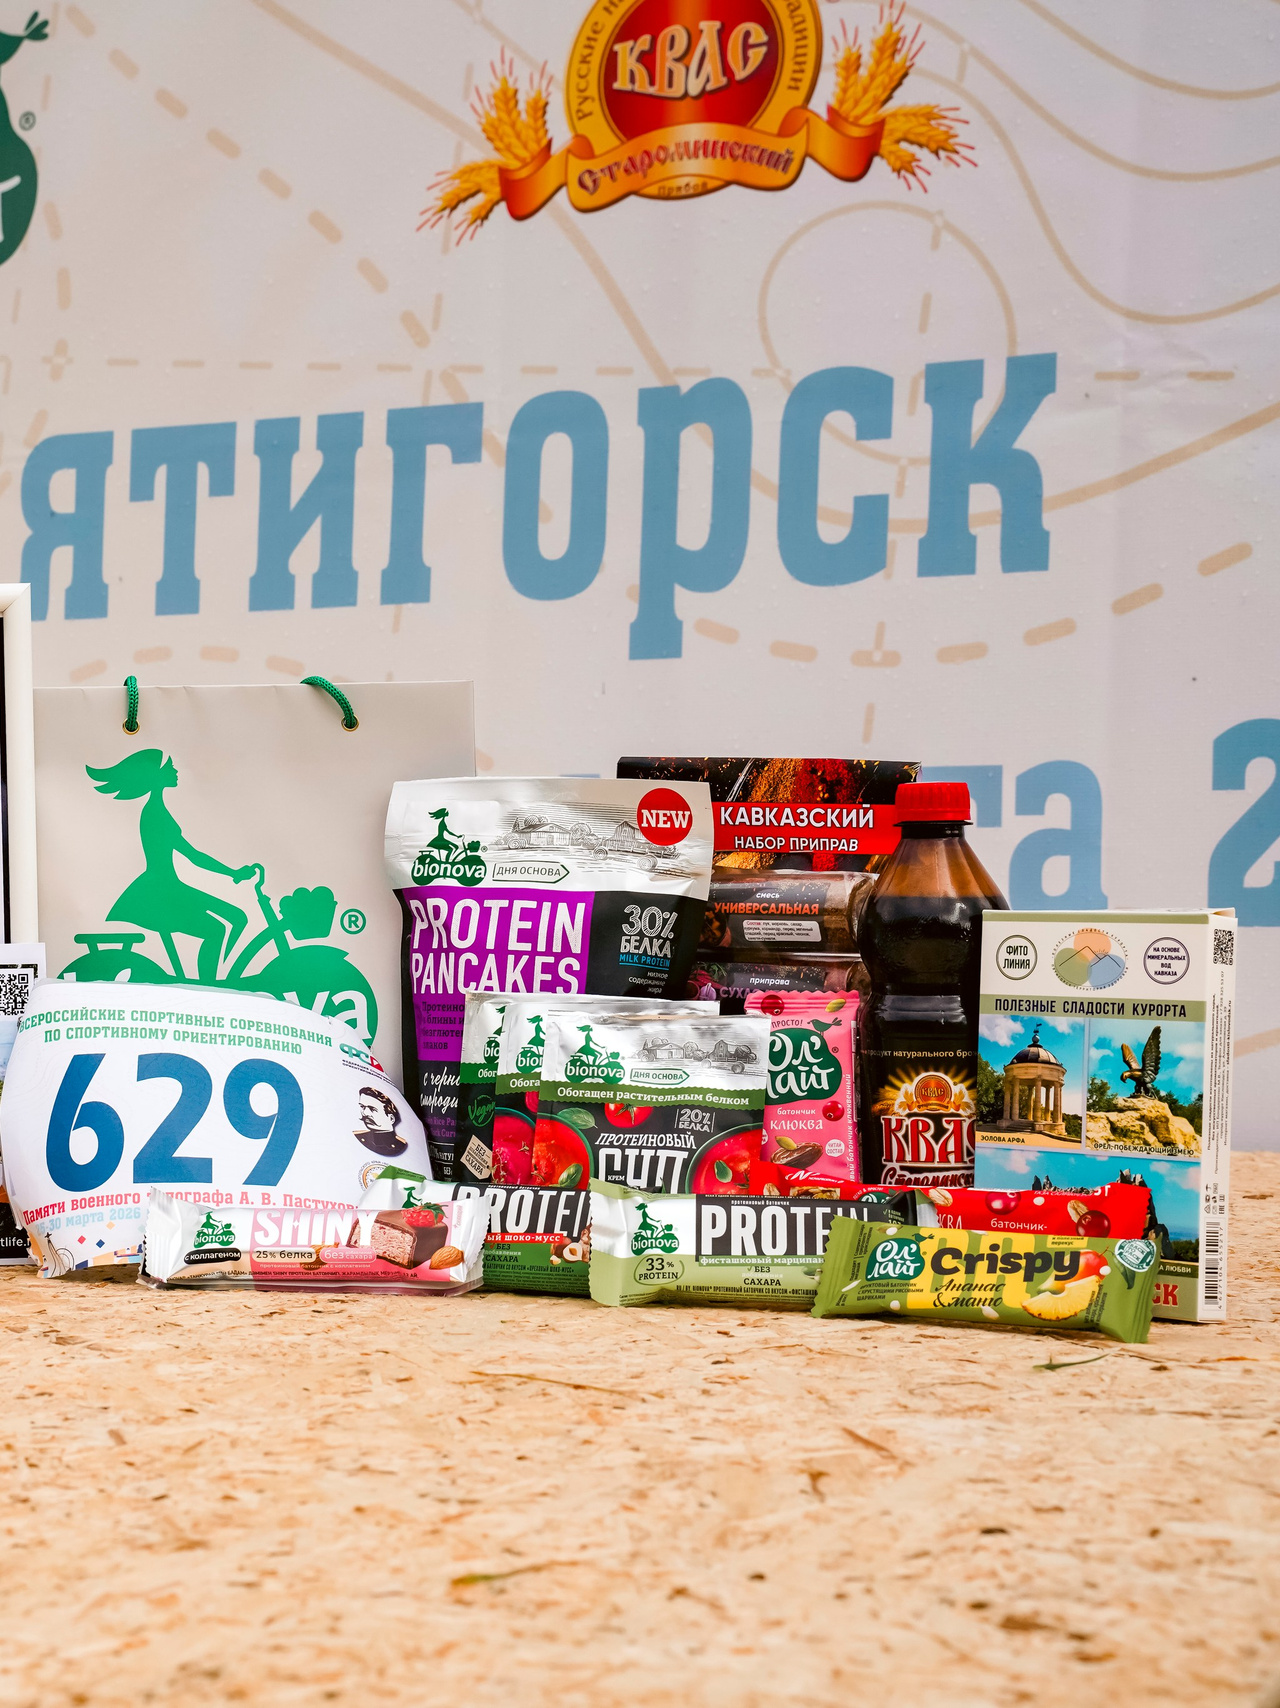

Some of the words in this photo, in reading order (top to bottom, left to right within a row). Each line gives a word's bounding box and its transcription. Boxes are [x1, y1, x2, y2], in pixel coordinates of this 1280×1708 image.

[612, 20, 769, 98] КВАС
[576, 20, 605, 121] Русские
[578, 139, 795, 195] Староминский
[641, 809, 691, 829] NEW
[720, 804, 874, 828] КАВКАЗСКИЙ
[734, 836, 786, 850] НАБОР
[789, 838, 858, 852] ПРИПРАВ
[413, 858, 486, 879] bionova
[496, 865, 517, 876] ДНЯ
[519, 865, 561, 877] ОСНОВА
[756, 891, 781, 899] смесь
[714, 902, 819, 916] УНИВЕРСАЛЬНАЯ
[410, 897, 586, 954] PROTEIN
[622, 904, 678, 940] 30%
[620, 936, 672, 959] БЕЛКА
[1006, 945, 1028, 957] ФИТО
[619, 954, 639, 964] MILK
[642, 954, 670, 968] PROTEIN
[1003, 958, 1031, 970] ЛИНИЯ
[1147, 954, 1186, 962] МИНЕРАЛЬНЫХ
[411, 951, 581, 995] PANCAKES
[628, 977, 666, 987] содержание
[750, 976, 790, 987] приправа
[995, 998, 1056, 1014] ПОЛЕЗНЫЕ
[1063, 1001, 1125, 1016] СЛАДОСТИ
[1132, 1002, 1187, 1018] КУРОРТА
[19, 1007, 126, 1033] ВСЕРОССИЙСКИЕ
[130, 1009, 225, 1029] СПОРТИВНЫЕ
[230, 1017, 333, 1047] СОРЕВНОВАНИЯ
[771, 1019, 803, 1028] ПРОСТО!
[44, 1028, 61, 1043] ПО
[66, 1026, 169, 1041] СПОРТИВНОМУ
[173, 1029, 303, 1056] ОРИЕНТИРОВАНИЮ
[893, 1049, 954, 1058] натурального
[566, 1062, 624, 1078] bionova
[633, 1071, 650, 1079] ДНЯ
[651, 1071, 684, 1081] ОСНОВА
[557, 1087, 614, 1099] Обогащен
[616, 1090, 703, 1102] растительным
[705, 1093, 749, 1105] белком
[680, 1108, 711, 1125] 20%
[777, 1108, 816, 1116] батончик
[46, 1053, 305, 1193] 629
[679, 1121, 710, 1133] БЕЛКА
[770, 1119, 823, 1131] клюква
[594, 1131, 697, 1149] ПРОТЕИНОВЫЙ
[980, 1135, 1006, 1143] ЭОЛОВА
[1007, 1136, 1025, 1144] АРФА
[23, 1201, 66, 1226] Памяти
[71, 1192, 141, 1212] военного
[65, 1211, 105, 1227] марта
[109, 1207, 141, 1220] 2026
[990, 1218, 1048, 1231] батончик-
[194, 1233, 235, 1244] bionova
[505, 1234, 560, 1243] шоко-мусс
[632, 1237, 679, 1250] bionova
[191, 1252, 240, 1262] коллагеном
[280, 1250, 313, 1259] белка
[324, 1249, 344, 1259] без
[700, 1256, 771, 1265] фисташковый
[774, 1256, 825, 1265] марципан
[867, 1260, 920, 1278] лайт
[930, 1243, 1081, 1283] Crispy
[638, 1271, 679, 1280] PROTEIN
[743, 1278, 781, 1286] САХАРА
[934, 1278, 1006, 1293] Ананас
